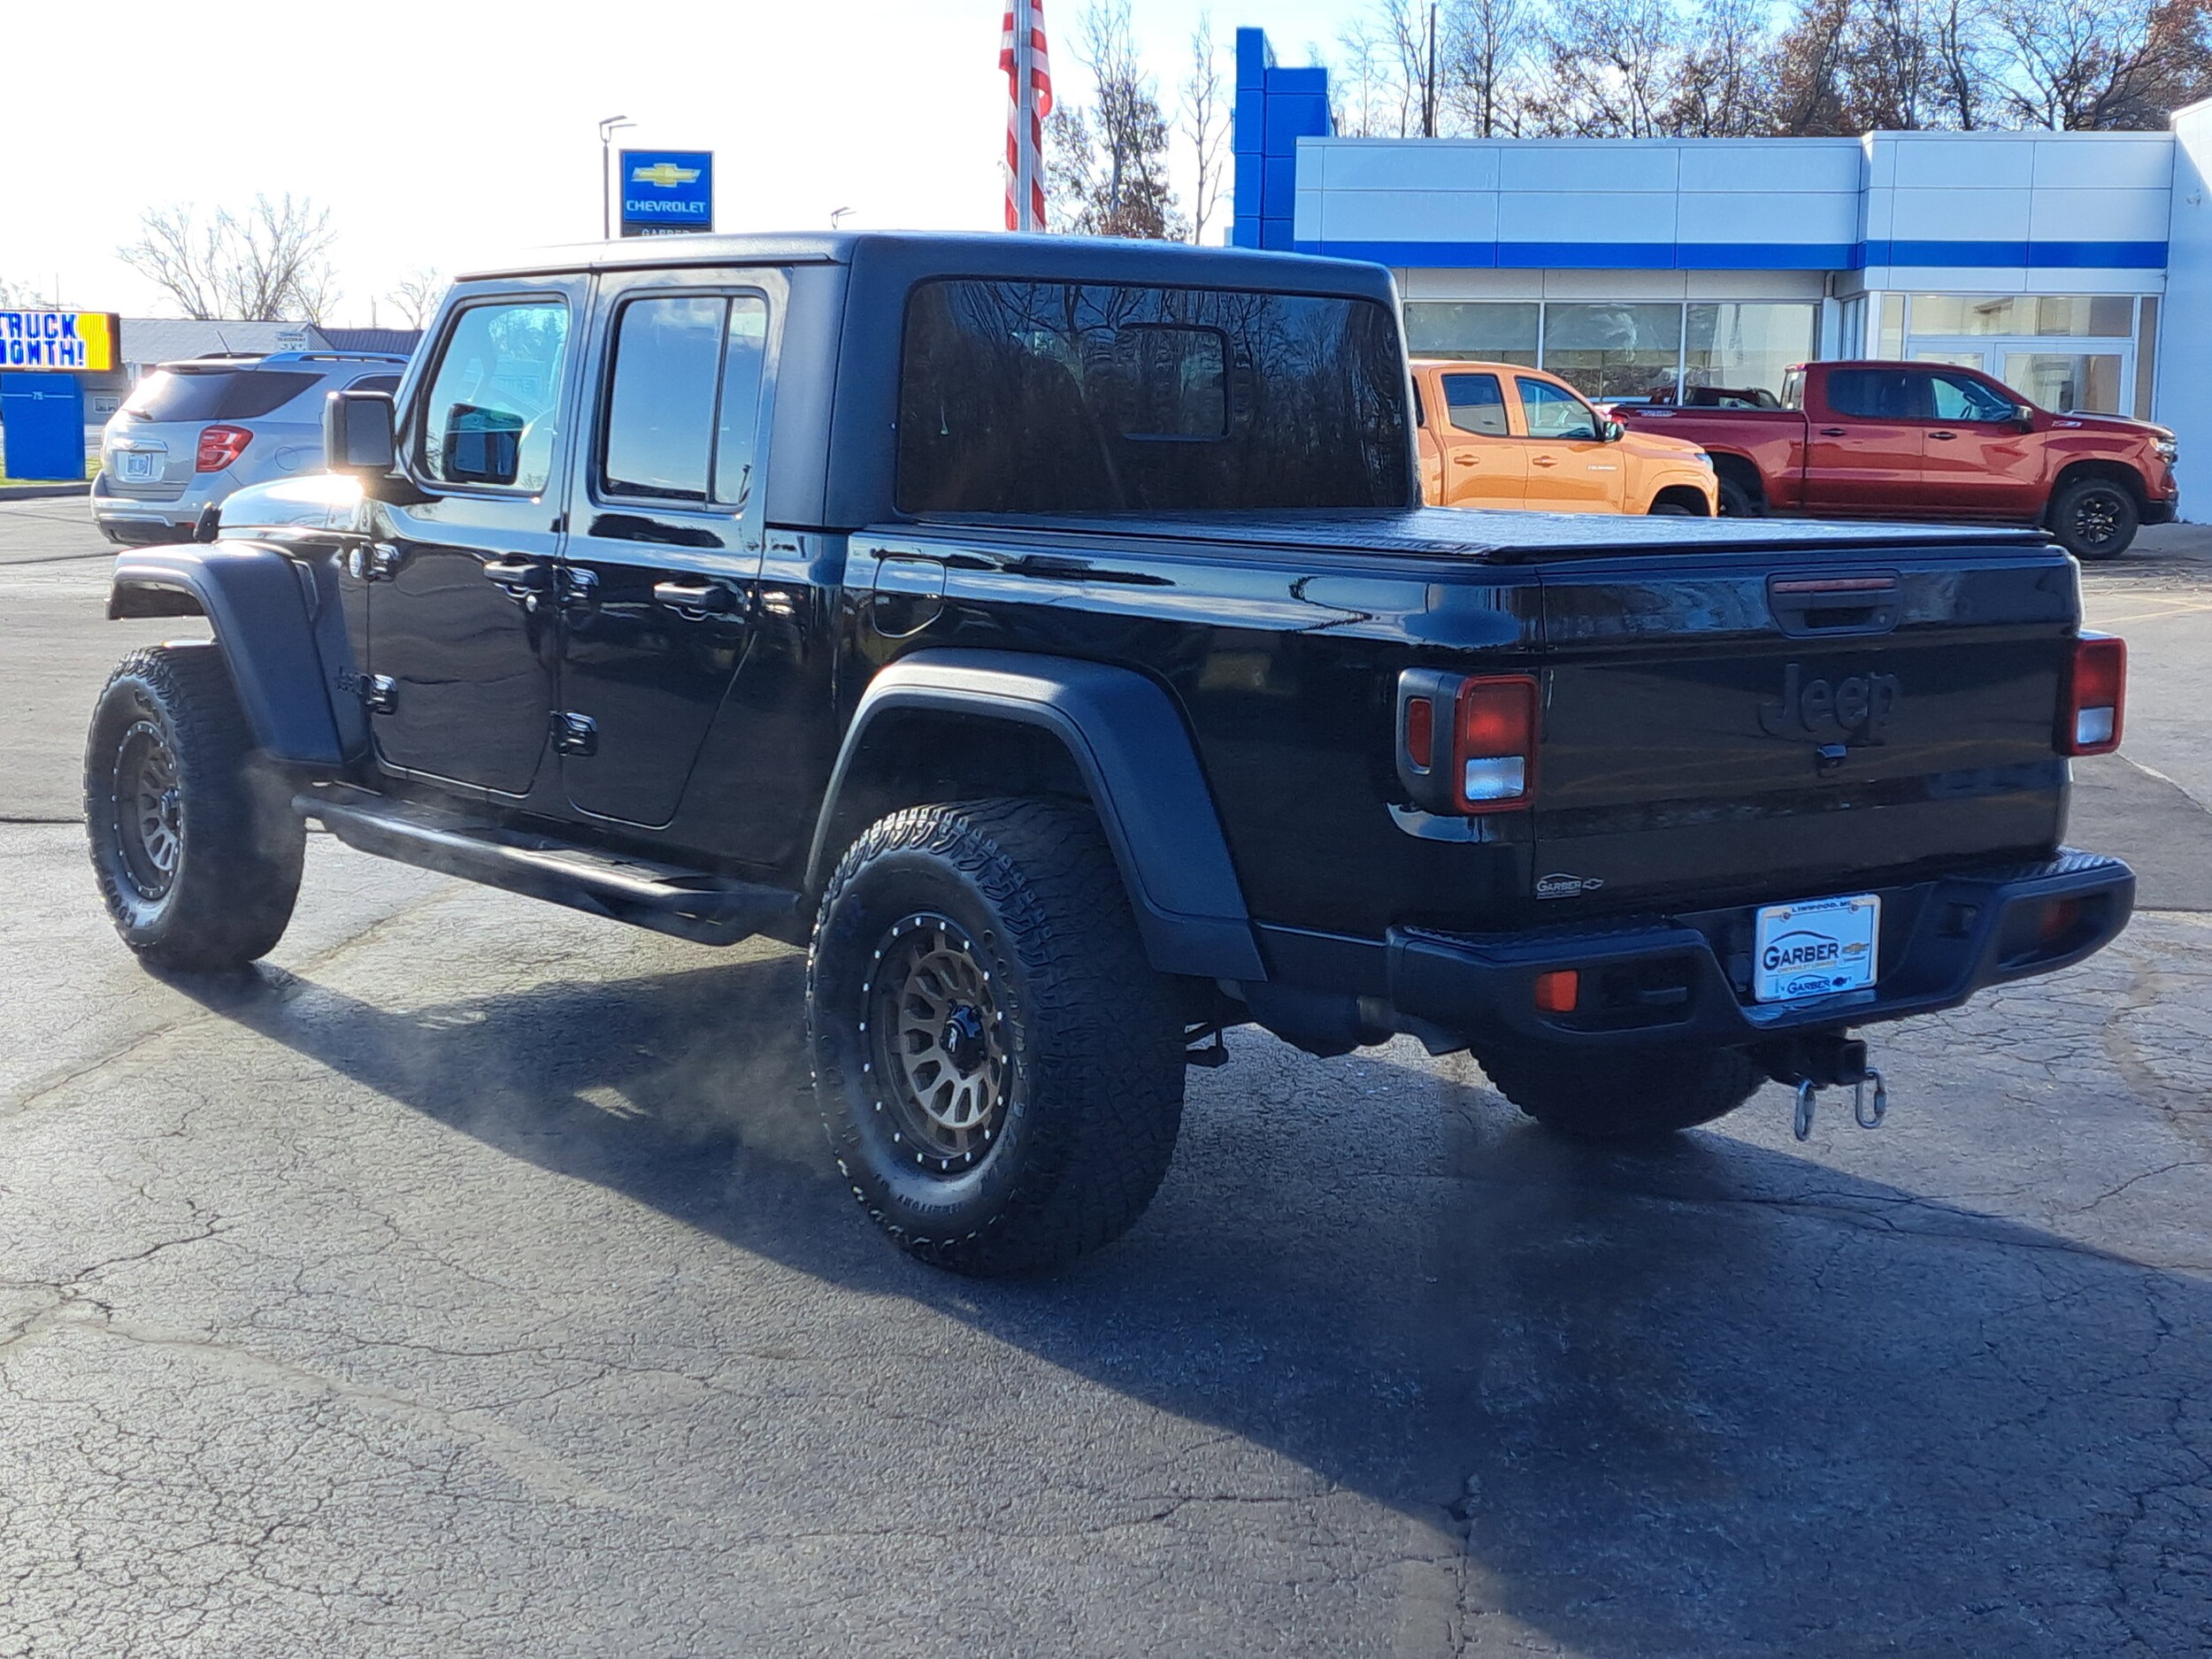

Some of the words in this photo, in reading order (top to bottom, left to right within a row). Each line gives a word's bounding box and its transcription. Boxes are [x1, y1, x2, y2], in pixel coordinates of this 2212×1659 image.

[626, 200, 707, 213] CHEVROLET
[1757, 663, 1901, 741] Jeep
[1537, 880, 1582, 893] GARBER
[1763, 942, 1839, 972] GARBER
[1786, 979, 1832, 995] GARBER
